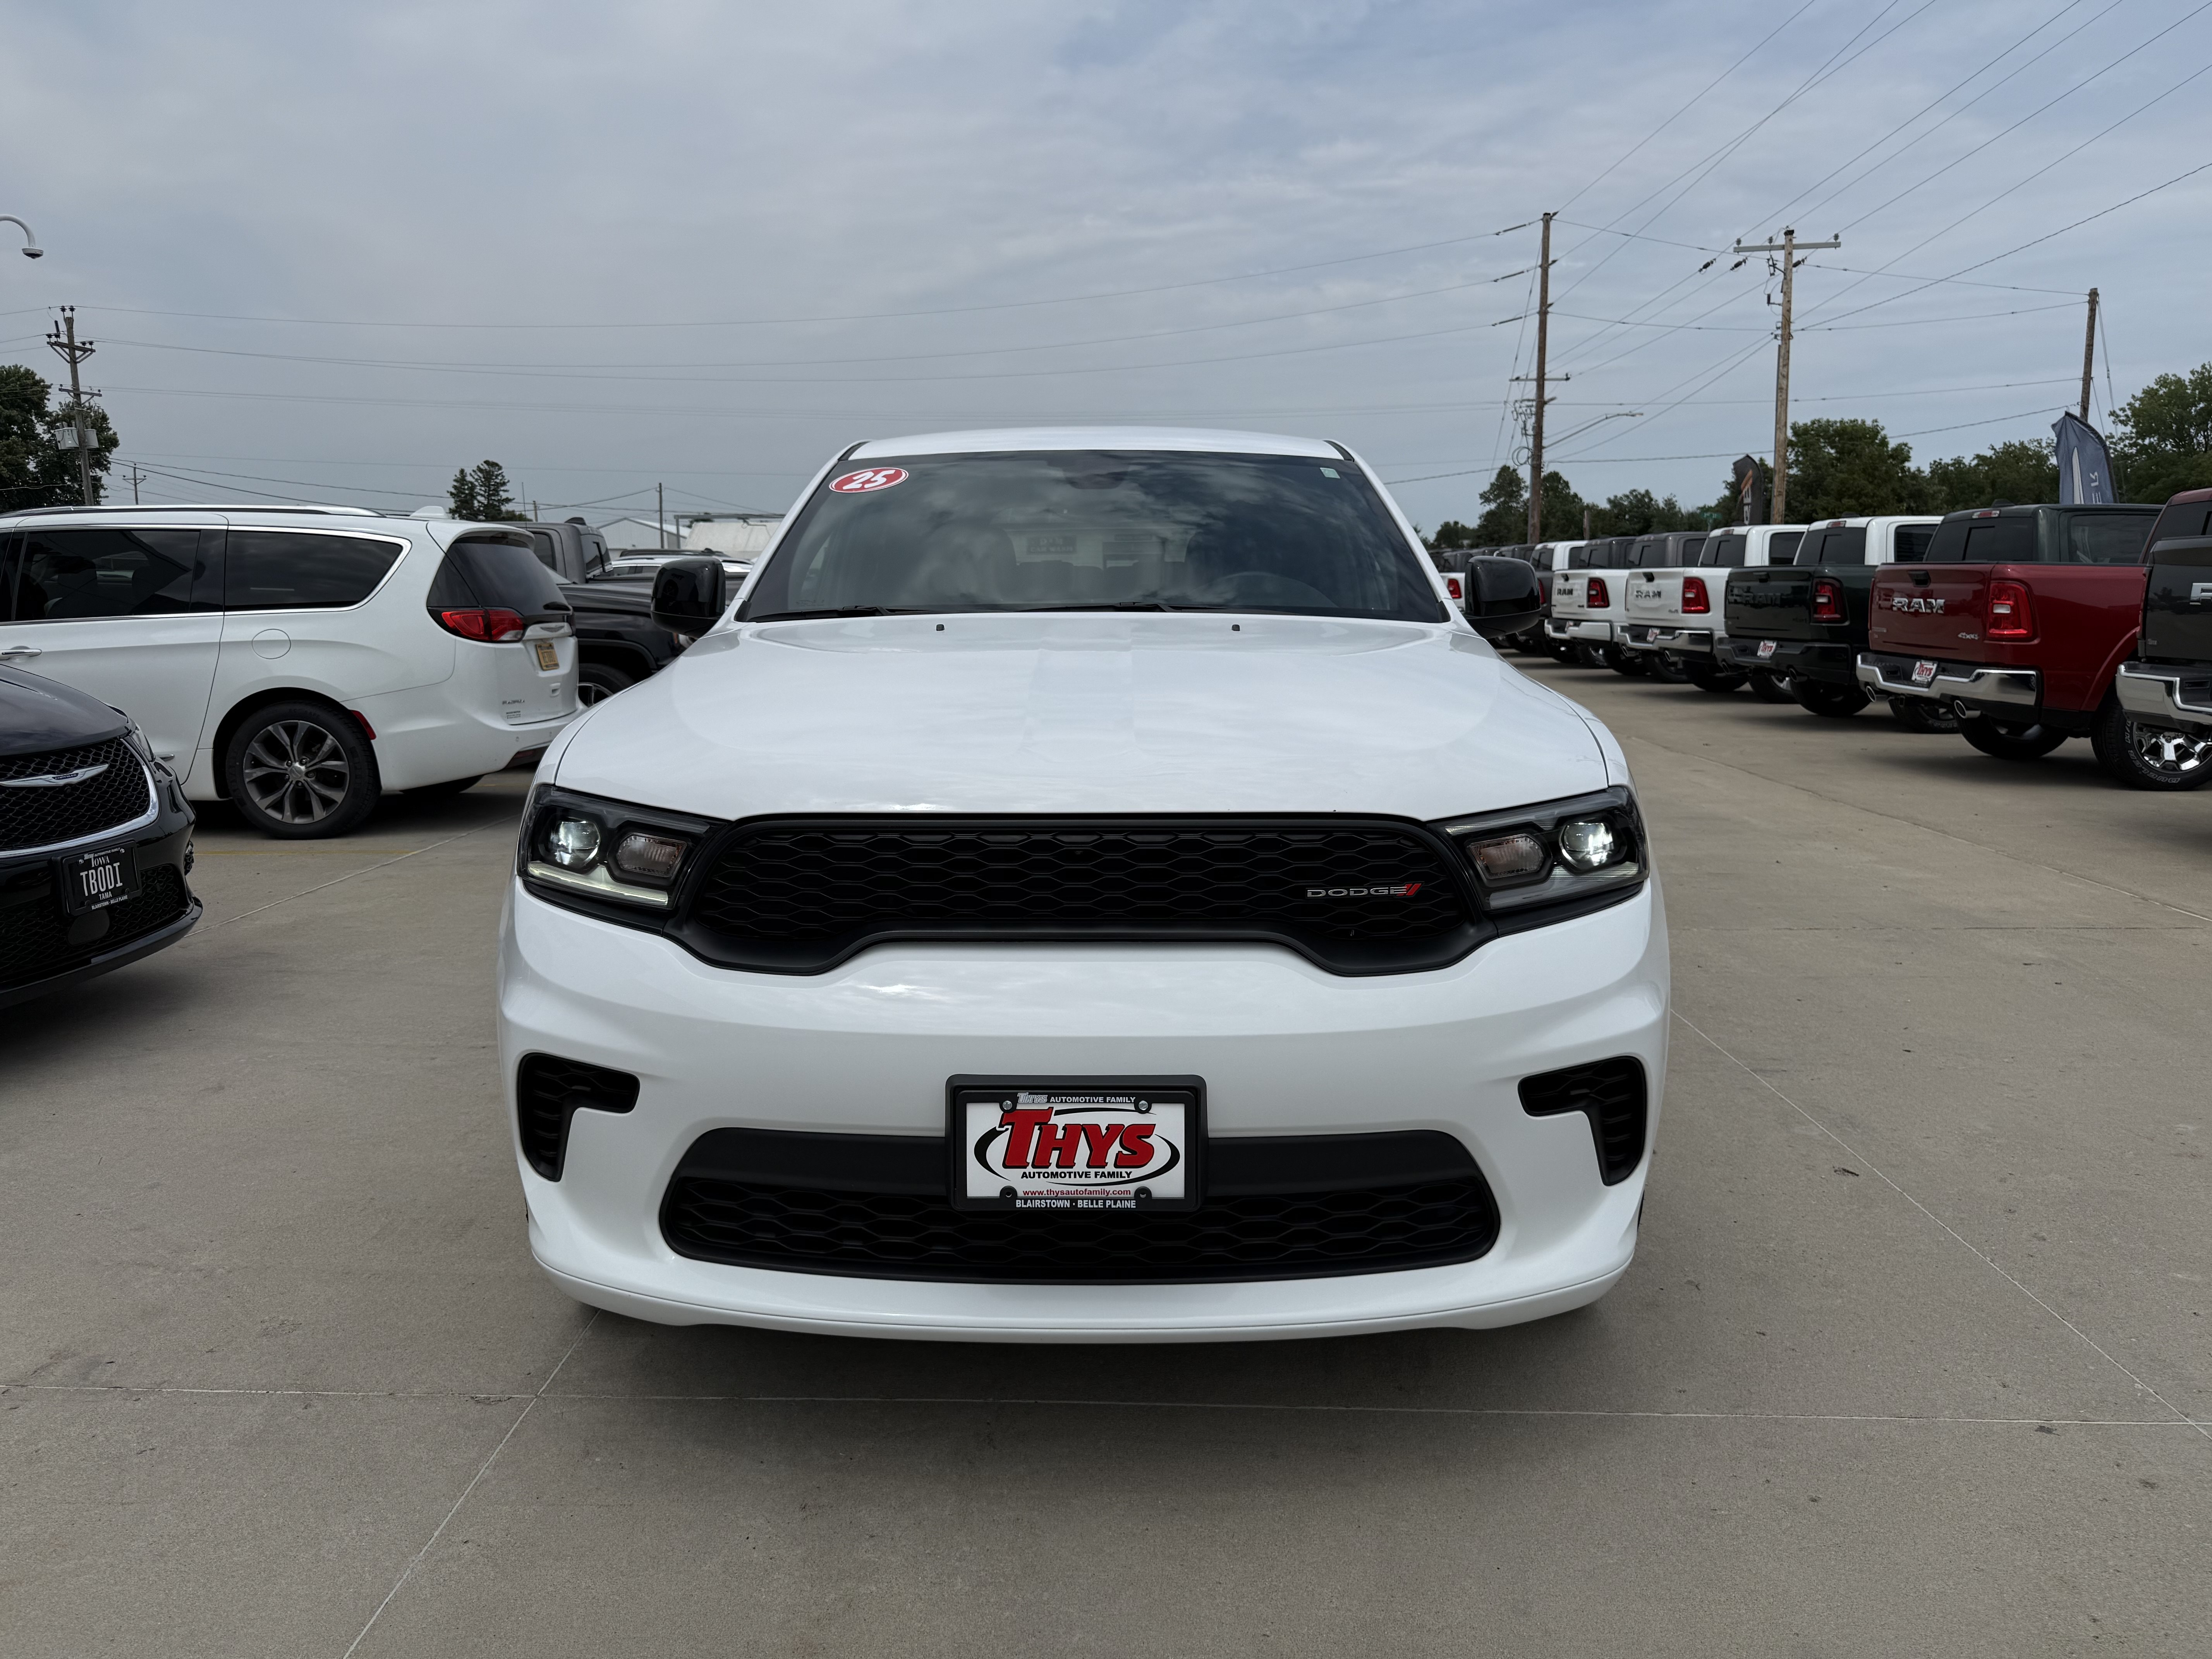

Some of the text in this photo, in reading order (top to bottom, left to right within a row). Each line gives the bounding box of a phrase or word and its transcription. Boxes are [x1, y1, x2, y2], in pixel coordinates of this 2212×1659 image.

[843, 469, 895, 489] 25
[1636, 590, 1661, 598] RAM
[1743, 593, 1781, 606] RAM
[1893, 598, 1949, 613] RAM
[99, 891, 112, 900] TAMA
[1307, 886, 1407, 897] DODGE
[999, 1107, 1156, 1169] THYS
[1023, 1188, 1131, 1197] www.thysautofamily.com
[1016, 1200, 1136, 1208] BLAIRSTOWN BELLE PLAINE
